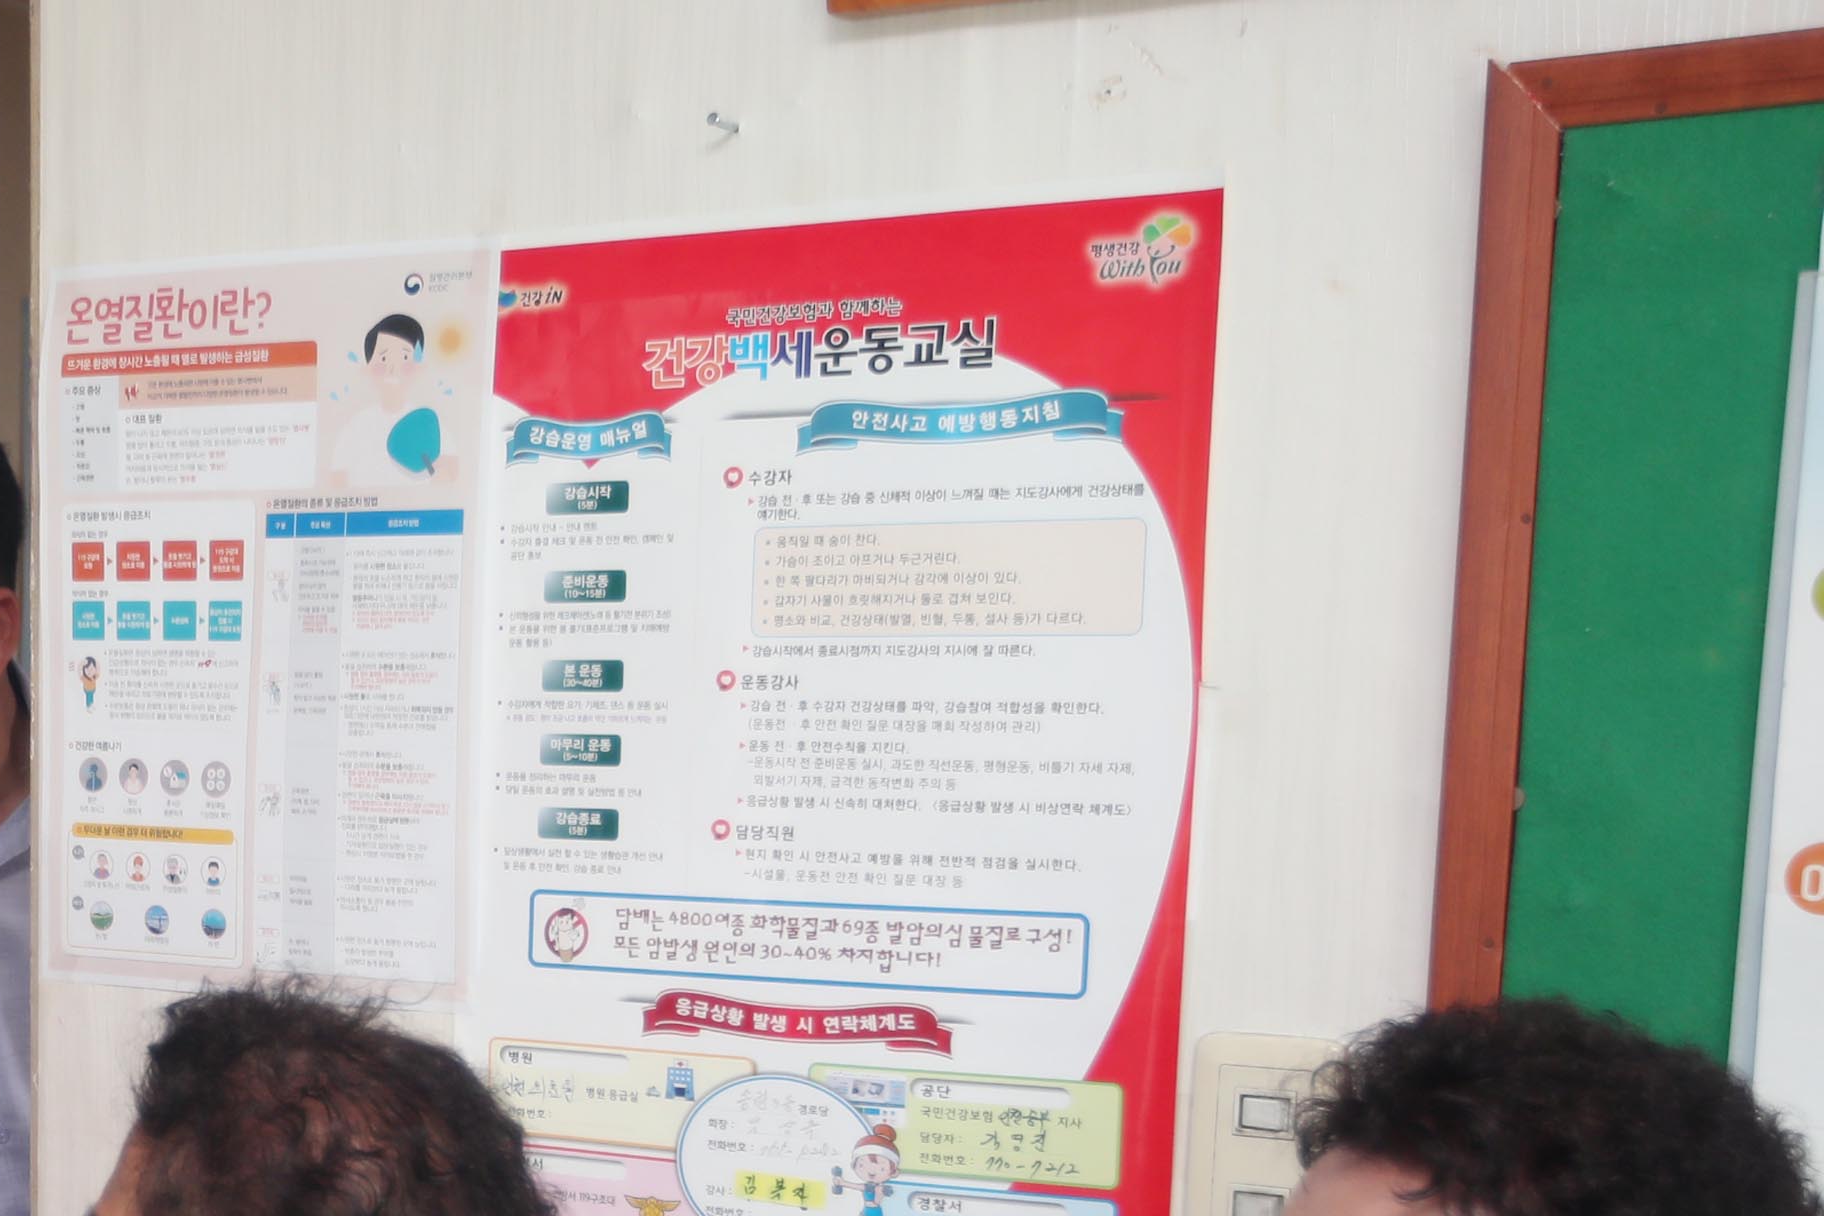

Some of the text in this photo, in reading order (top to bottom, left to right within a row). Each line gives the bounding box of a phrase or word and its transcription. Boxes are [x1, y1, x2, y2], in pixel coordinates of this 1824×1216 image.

[1091, 241, 1140, 257] 평생건강
[1100, 258, 1145, 280] With
[66, 287, 272, 345] 온열질환이란?
[727, 297, 902, 326] 국민건강보험과 함께하는
[643, 317, 997, 389] 건강백세운동교실
[852, 410, 927, 432] 안전사고
[530, 420, 647, 451] 강습운영 매뉴얼
[749, 470, 792, 486] 수강자
[564, 485, 611, 500] 강습시작
[758, 495, 777, 507] 강습
[816, 493, 836, 505] 또는
[841, 492, 860, 505] 강습
[915, 490, 946, 502] 이상이
[1016, 486, 1082, 499] 지도강사에게
[1088, 483, 1144, 497] 건강상태를
[741, 674, 799, 691] 운동강사
[736, 825, 794, 841] 담당직원
[616, 908, 664, 931] 담배는
[614, 936, 640, 958] 모든
[704, 940, 755, 964] 원인의
[838, 948, 941, 973] 차지합니다!
[675, 998, 916, 1034] 응급상황 발생 시 연락체계도
[508, 1051, 532, 1064] 병원
[921, 1085, 951, 1098] 공단
[798, 1105, 828, 1117] 경로당
[921, 1106, 993, 1123] 국민건강보험
[1057, 1116, 1082, 1128] 지사
[918, 1198, 961, 1213] 경찰서
